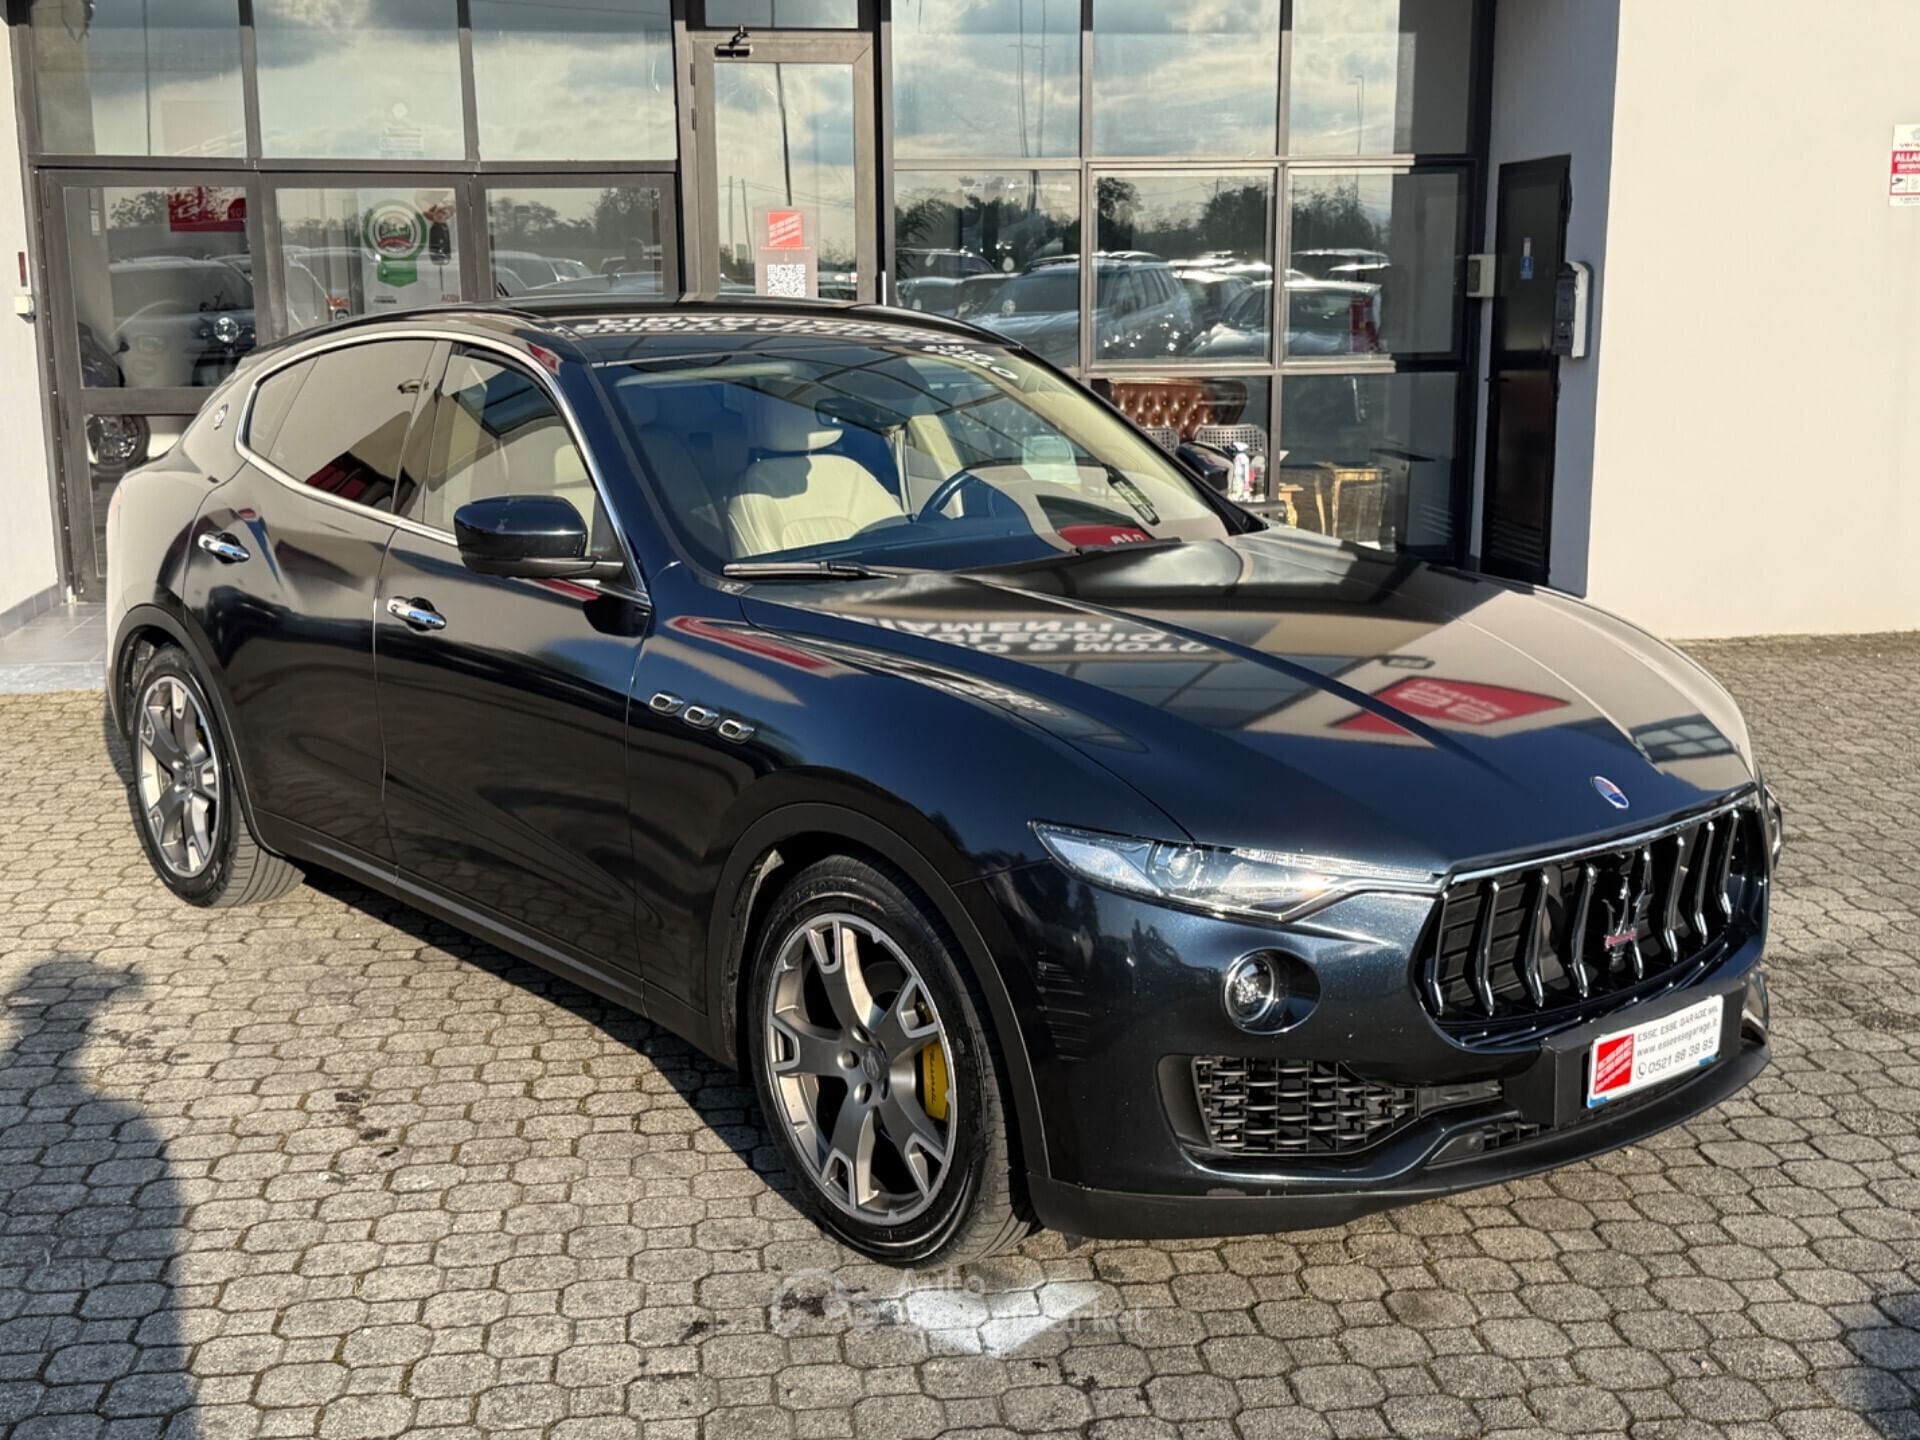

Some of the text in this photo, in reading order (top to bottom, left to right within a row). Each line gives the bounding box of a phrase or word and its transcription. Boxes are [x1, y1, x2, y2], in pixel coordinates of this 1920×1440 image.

[1637, 1027, 1658, 1042] ESSE
[1660, 1020, 1678, 1035] ESSE
[1648, 1055, 1672, 1074] 0521
